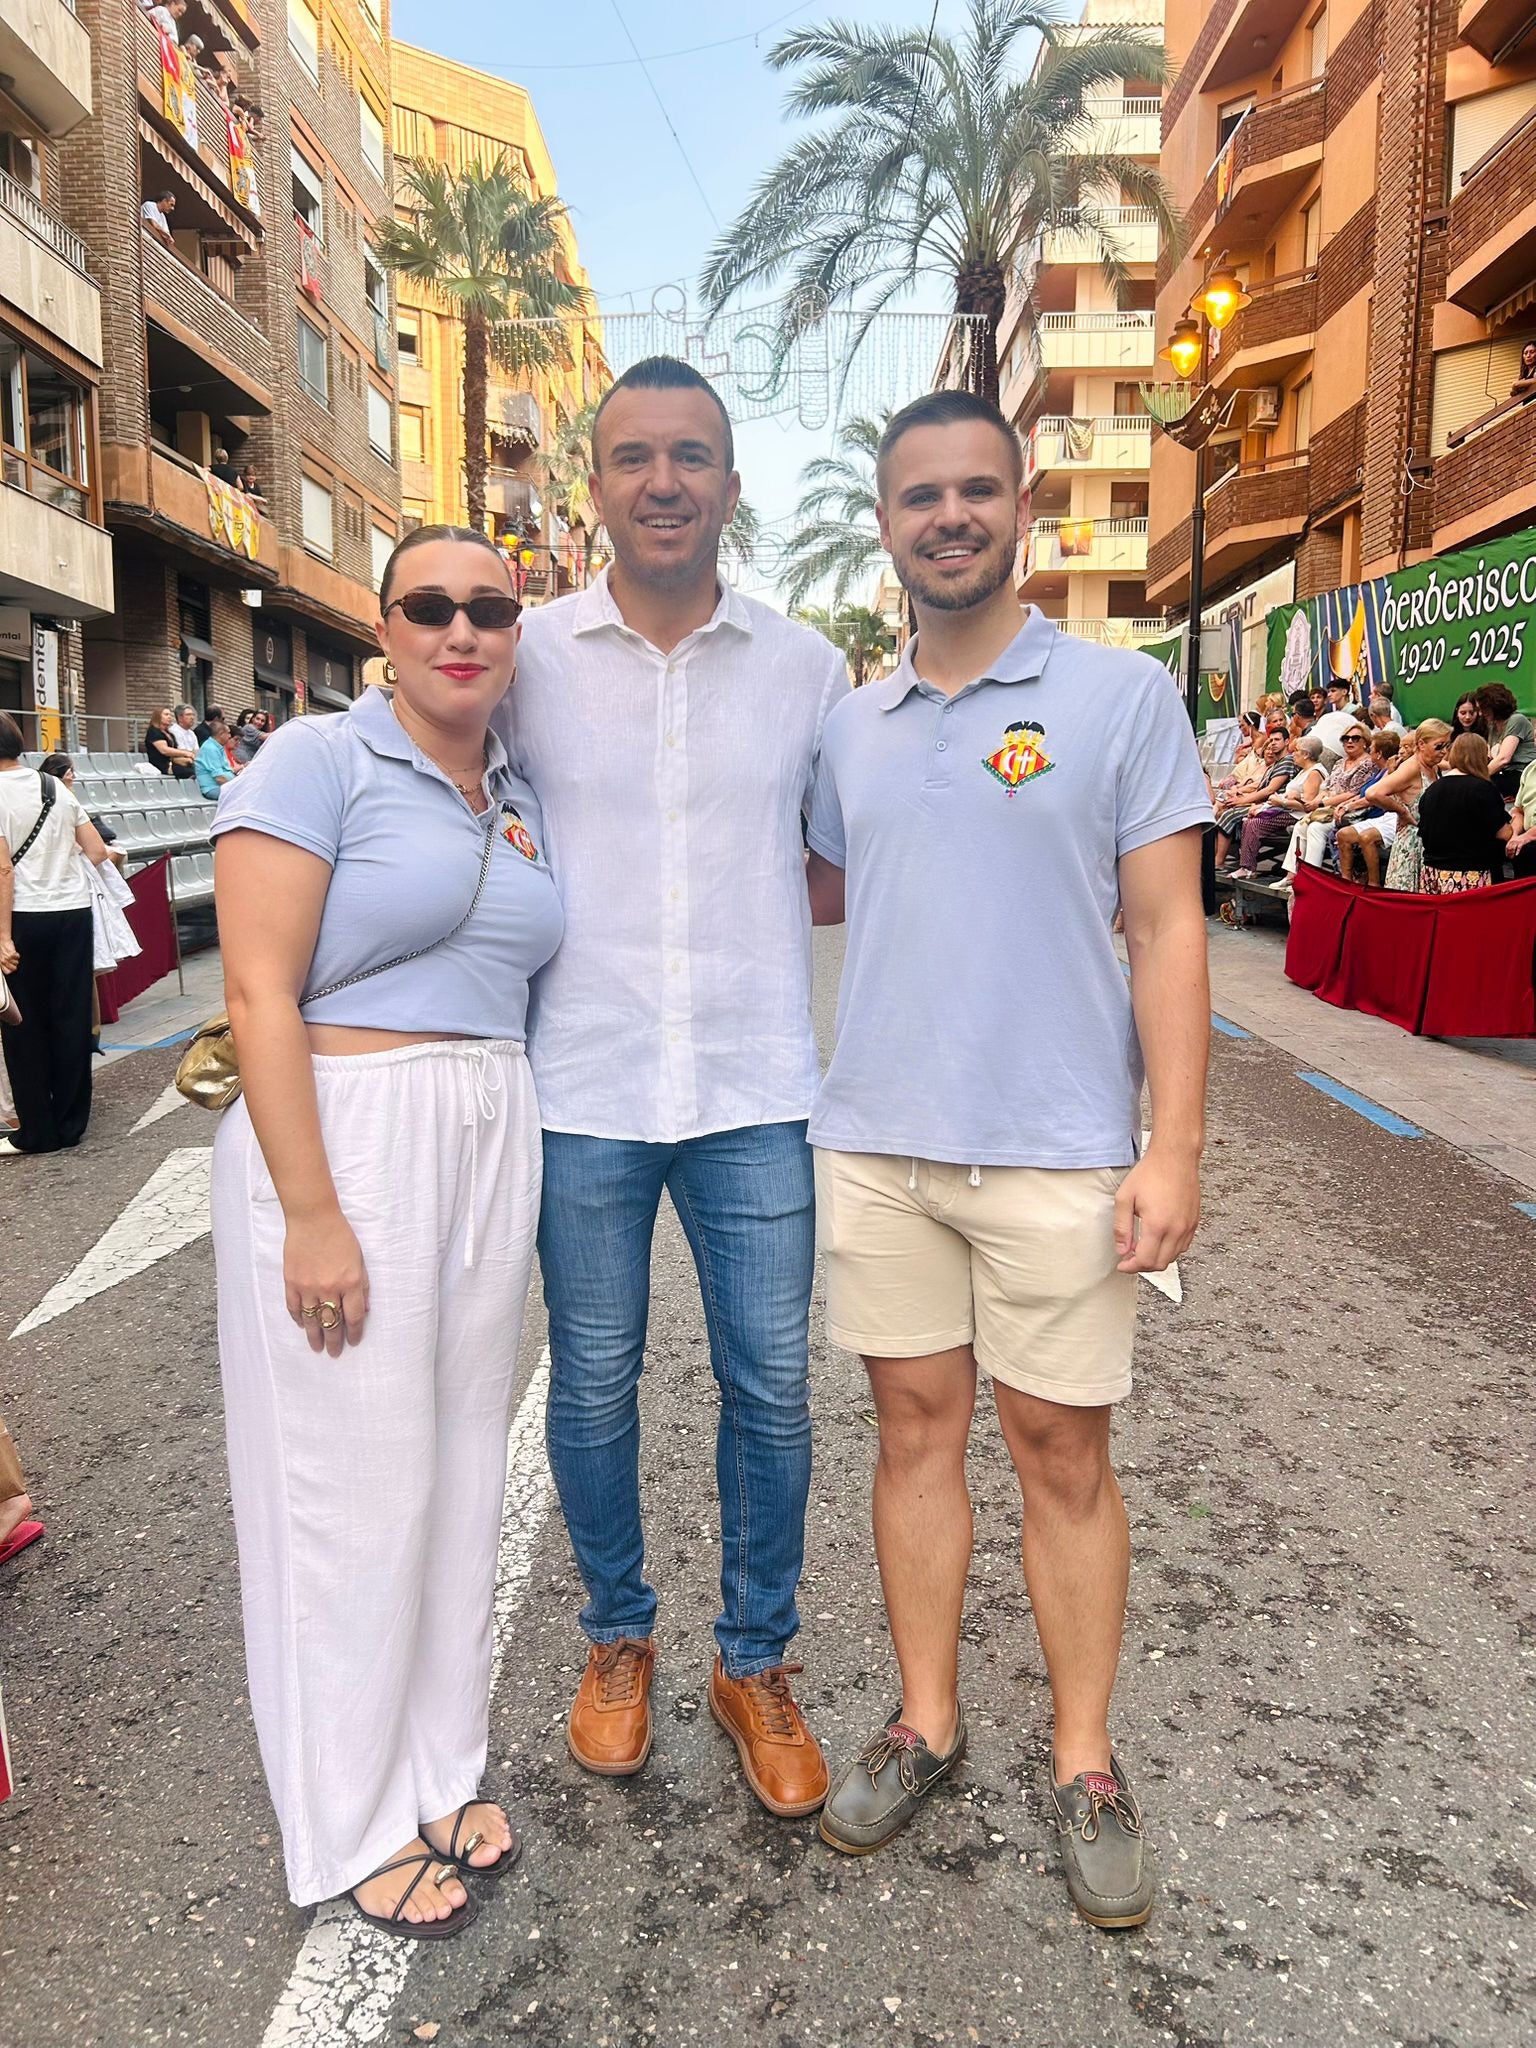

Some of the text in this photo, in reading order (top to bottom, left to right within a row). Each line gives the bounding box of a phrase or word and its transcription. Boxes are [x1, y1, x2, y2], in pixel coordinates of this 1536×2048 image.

[0, 632, 21, 641] ntal
[1398, 621, 1527, 684] 1920 - 2025
